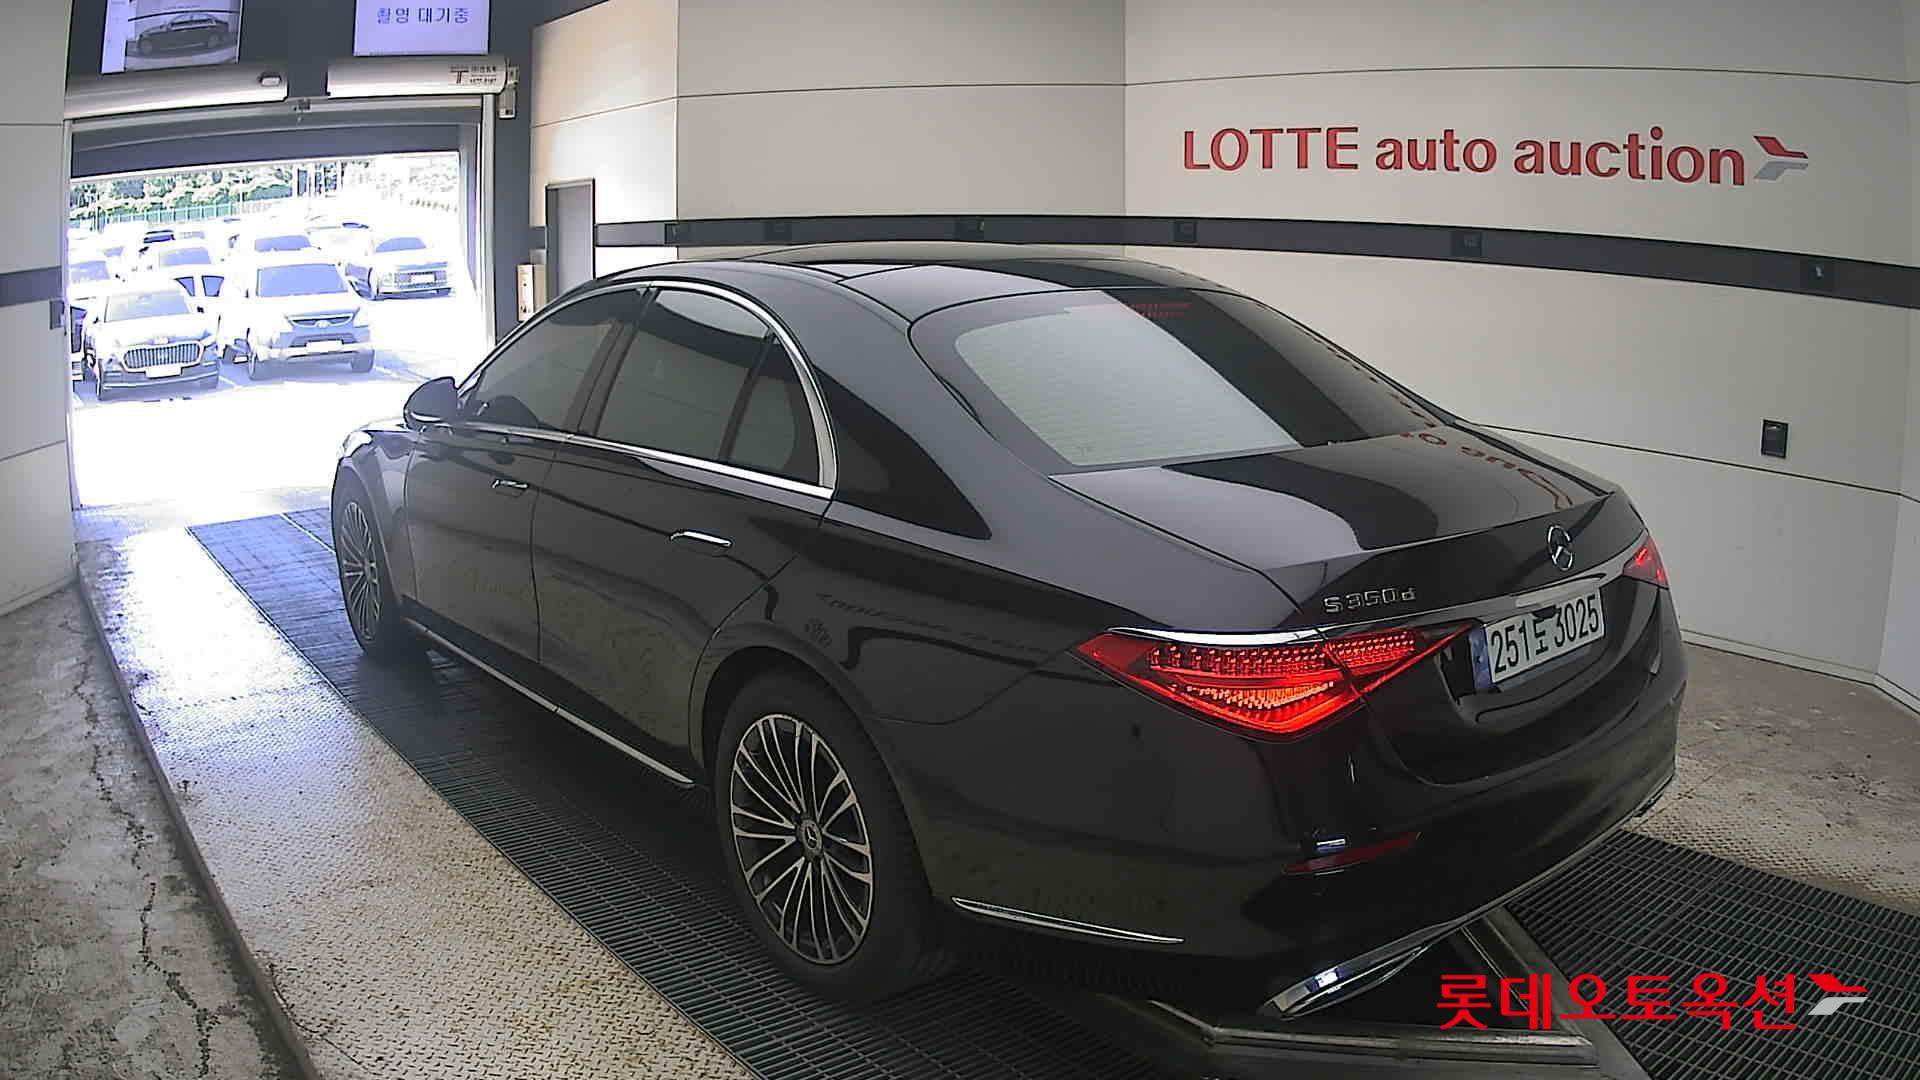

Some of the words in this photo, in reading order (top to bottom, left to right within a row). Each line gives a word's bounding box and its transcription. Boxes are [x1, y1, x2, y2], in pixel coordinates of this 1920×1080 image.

[418, 7, 469, 24] 대기중
[1183, 127, 1360, 171] LOTTE
[1376, 131, 1498, 173] auto
[1513, 126, 1745, 185] auction
